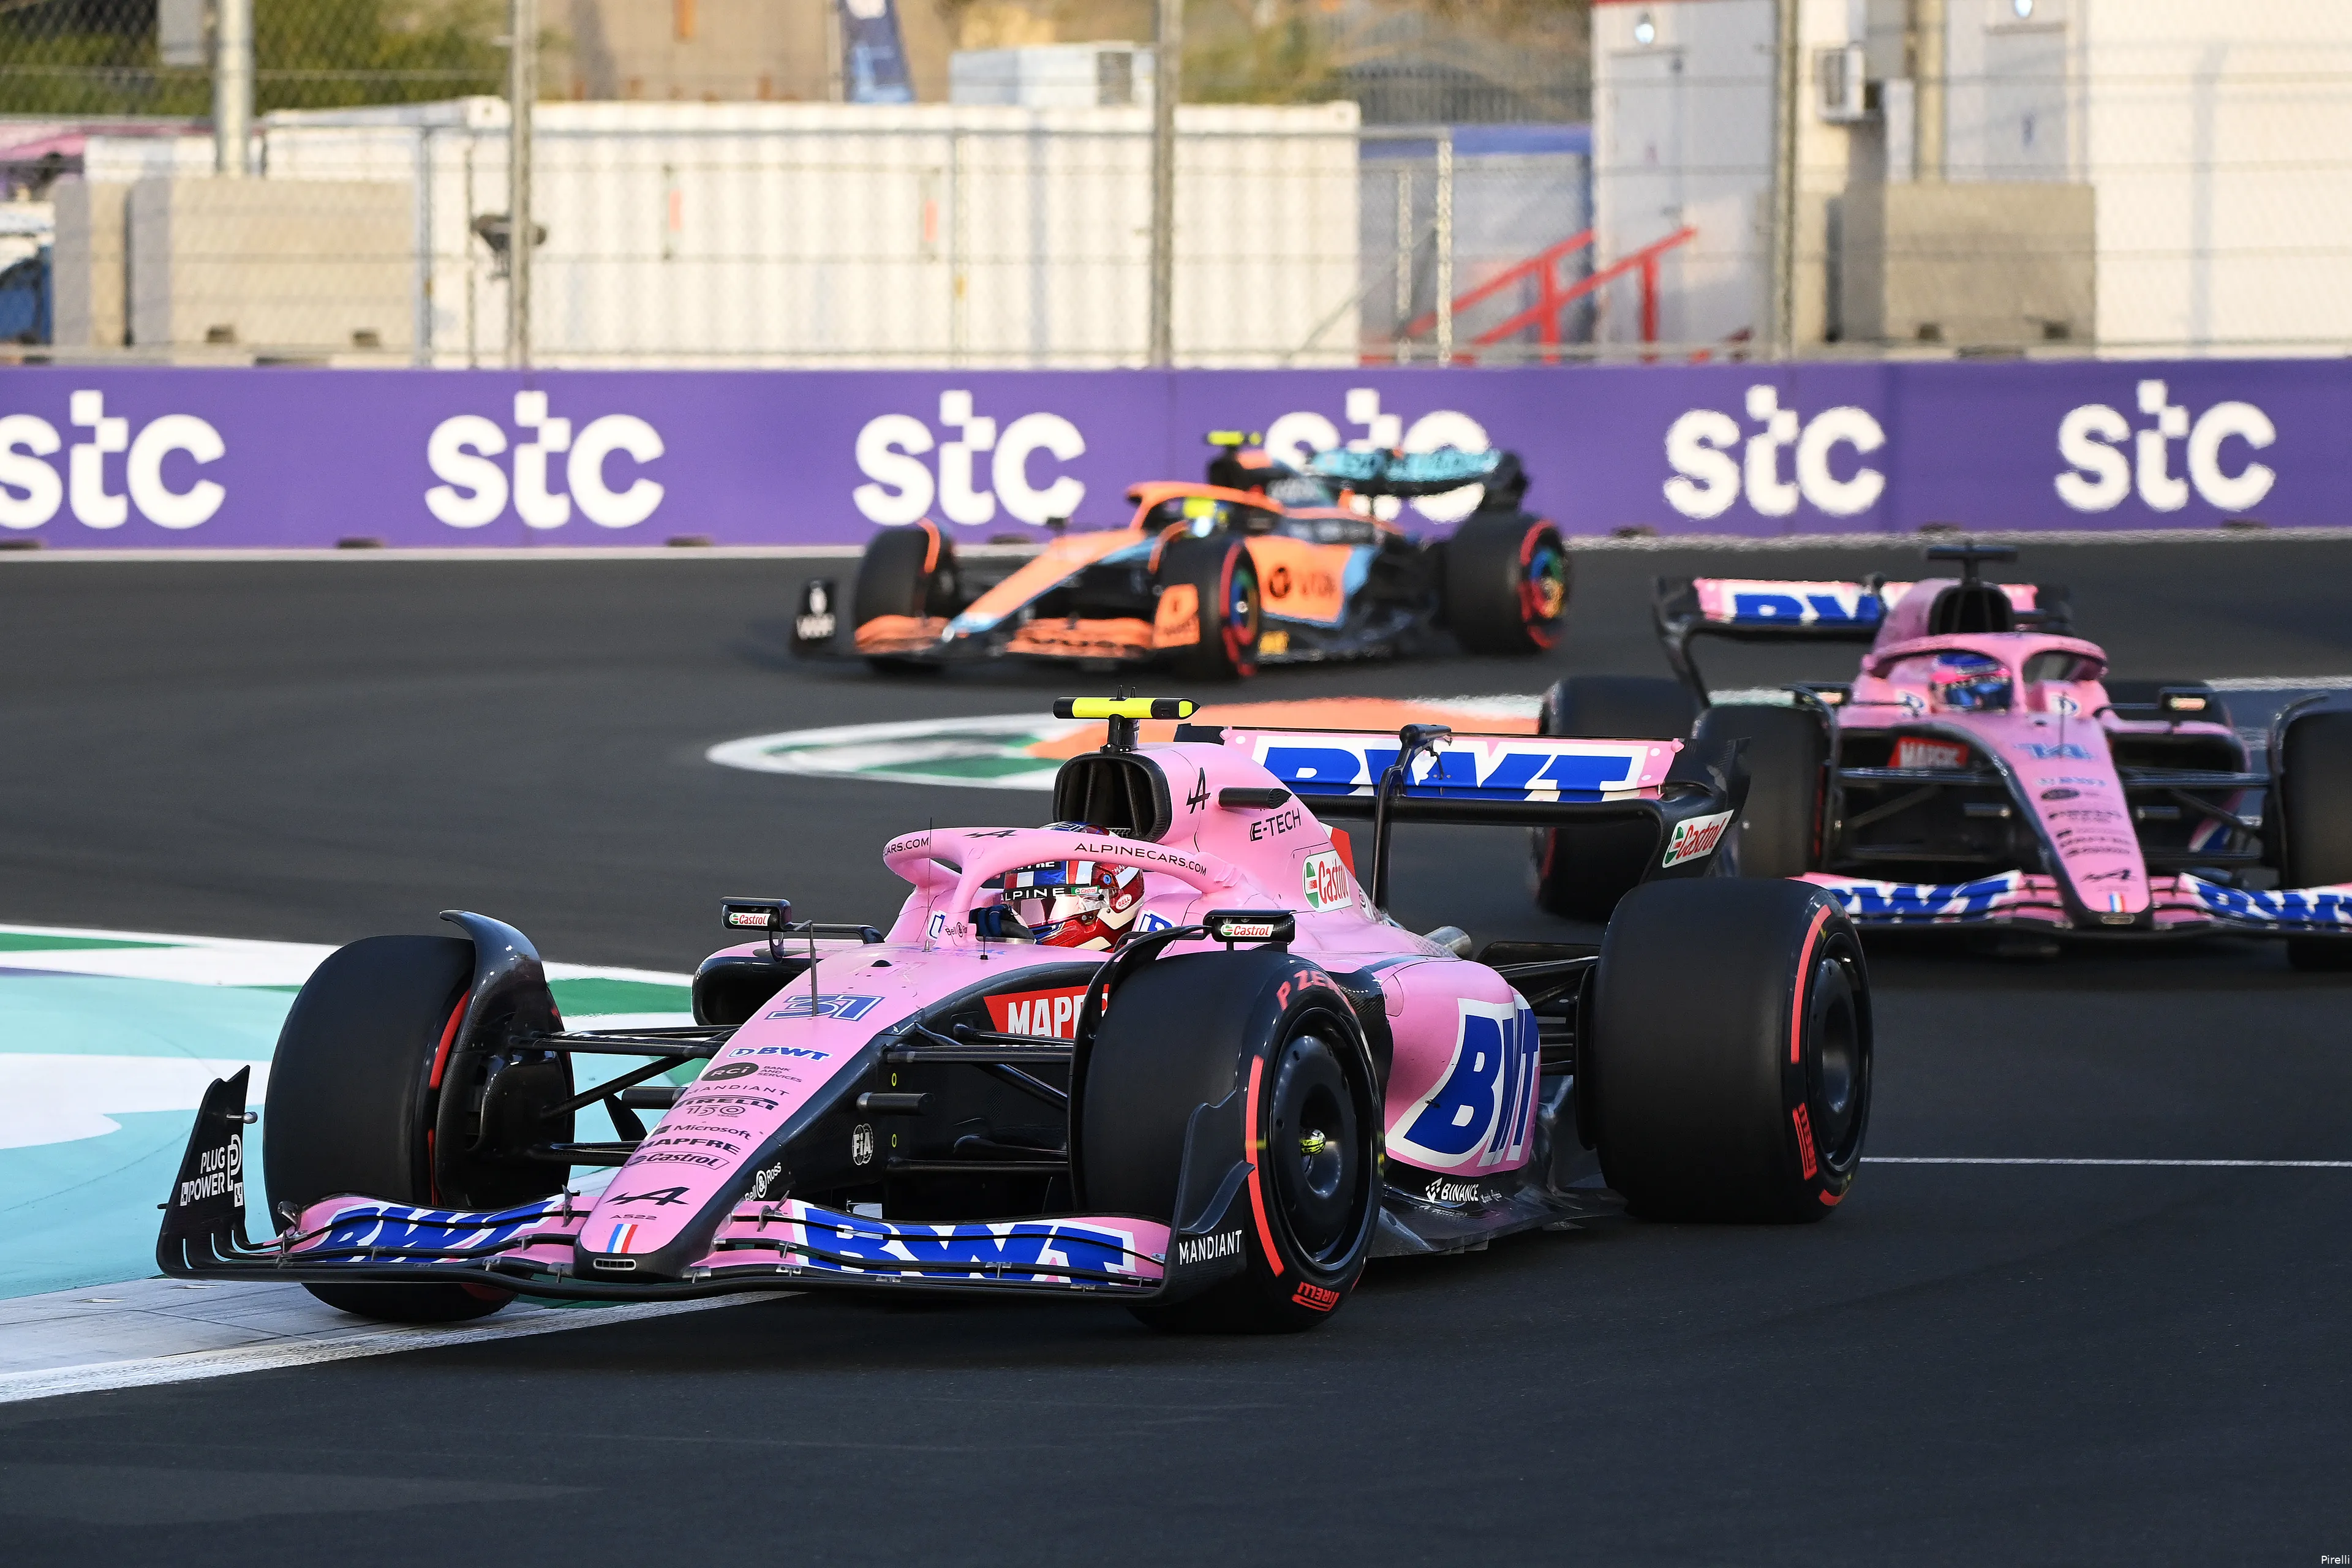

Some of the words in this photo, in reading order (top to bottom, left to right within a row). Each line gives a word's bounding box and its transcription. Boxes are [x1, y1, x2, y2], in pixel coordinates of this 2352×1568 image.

[0, 390, 225, 529] stc
[425, 390, 665, 529] stc
[853, 390, 1085, 526] stc
[1663, 385, 1885, 519] stc
[2055, 380, 2276, 511] stc
[1250, 808, 1302, 842] E-TECH
[1676, 818, 1727, 860] Castrol
[1074, 842, 1207, 877] ALPINECARS.COM
[1000, 888, 1065, 902] ALPINE
[1318, 859, 1349, 905] Castrol
[1118, 896, 1131, 907] BELL
[739, 914, 767, 925] Castrol
[1232, 925, 1270, 937] Castrol
[763, 993, 886, 1022] 31
[1276, 981, 1292, 1011] P
[756, 1047, 830, 1061] BWT
[685, 1085, 790, 1096] MANDIANT
[756, 1072, 802, 1083] SERVICES
[636, 1138, 741, 1155] MAPFRE
[673, 1125, 752, 1140] Microsoft
[200, 1147, 225, 1174] PLUG
[646, 1153, 720, 1167] Castrol
[188, 1172, 225, 1203] POWER
[1441, 1183, 1479, 1202] BINANCE
[1178, 1229, 1243, 1266] MANDIANT
[1292, 1281, 1340, 1311] PIRELLI
